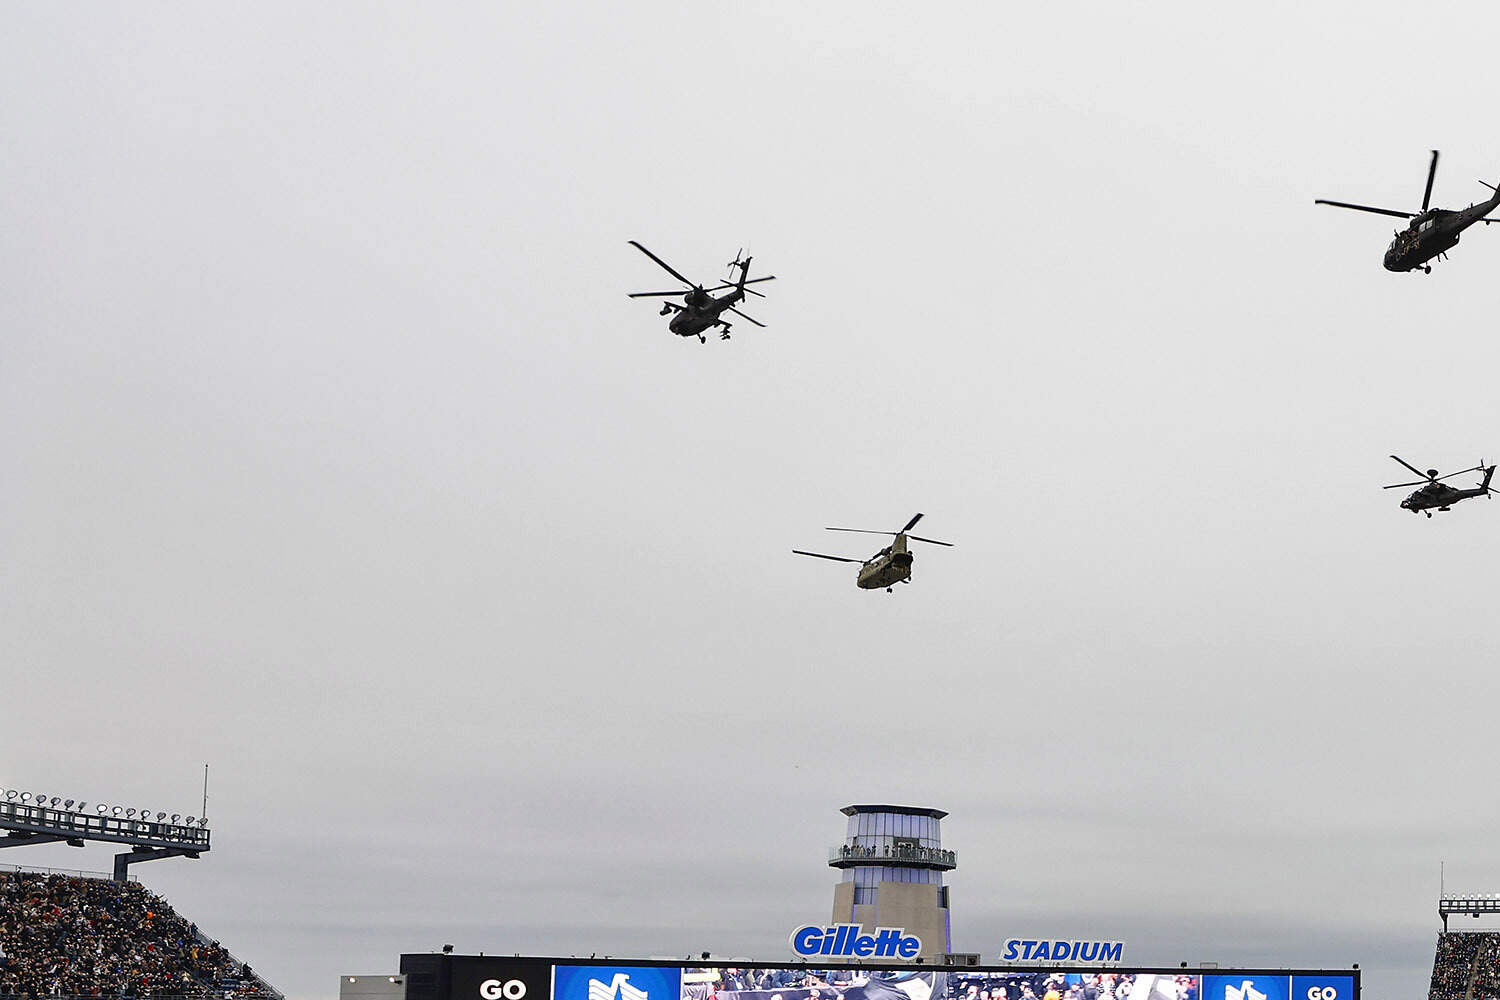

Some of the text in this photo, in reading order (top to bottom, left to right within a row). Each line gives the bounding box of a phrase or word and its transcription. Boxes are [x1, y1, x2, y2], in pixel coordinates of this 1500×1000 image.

[792, 923, 921, 957] Gillette
[1003, 940, 1123, 961] STADIUM
[479, 979, 527, 1000] GO
